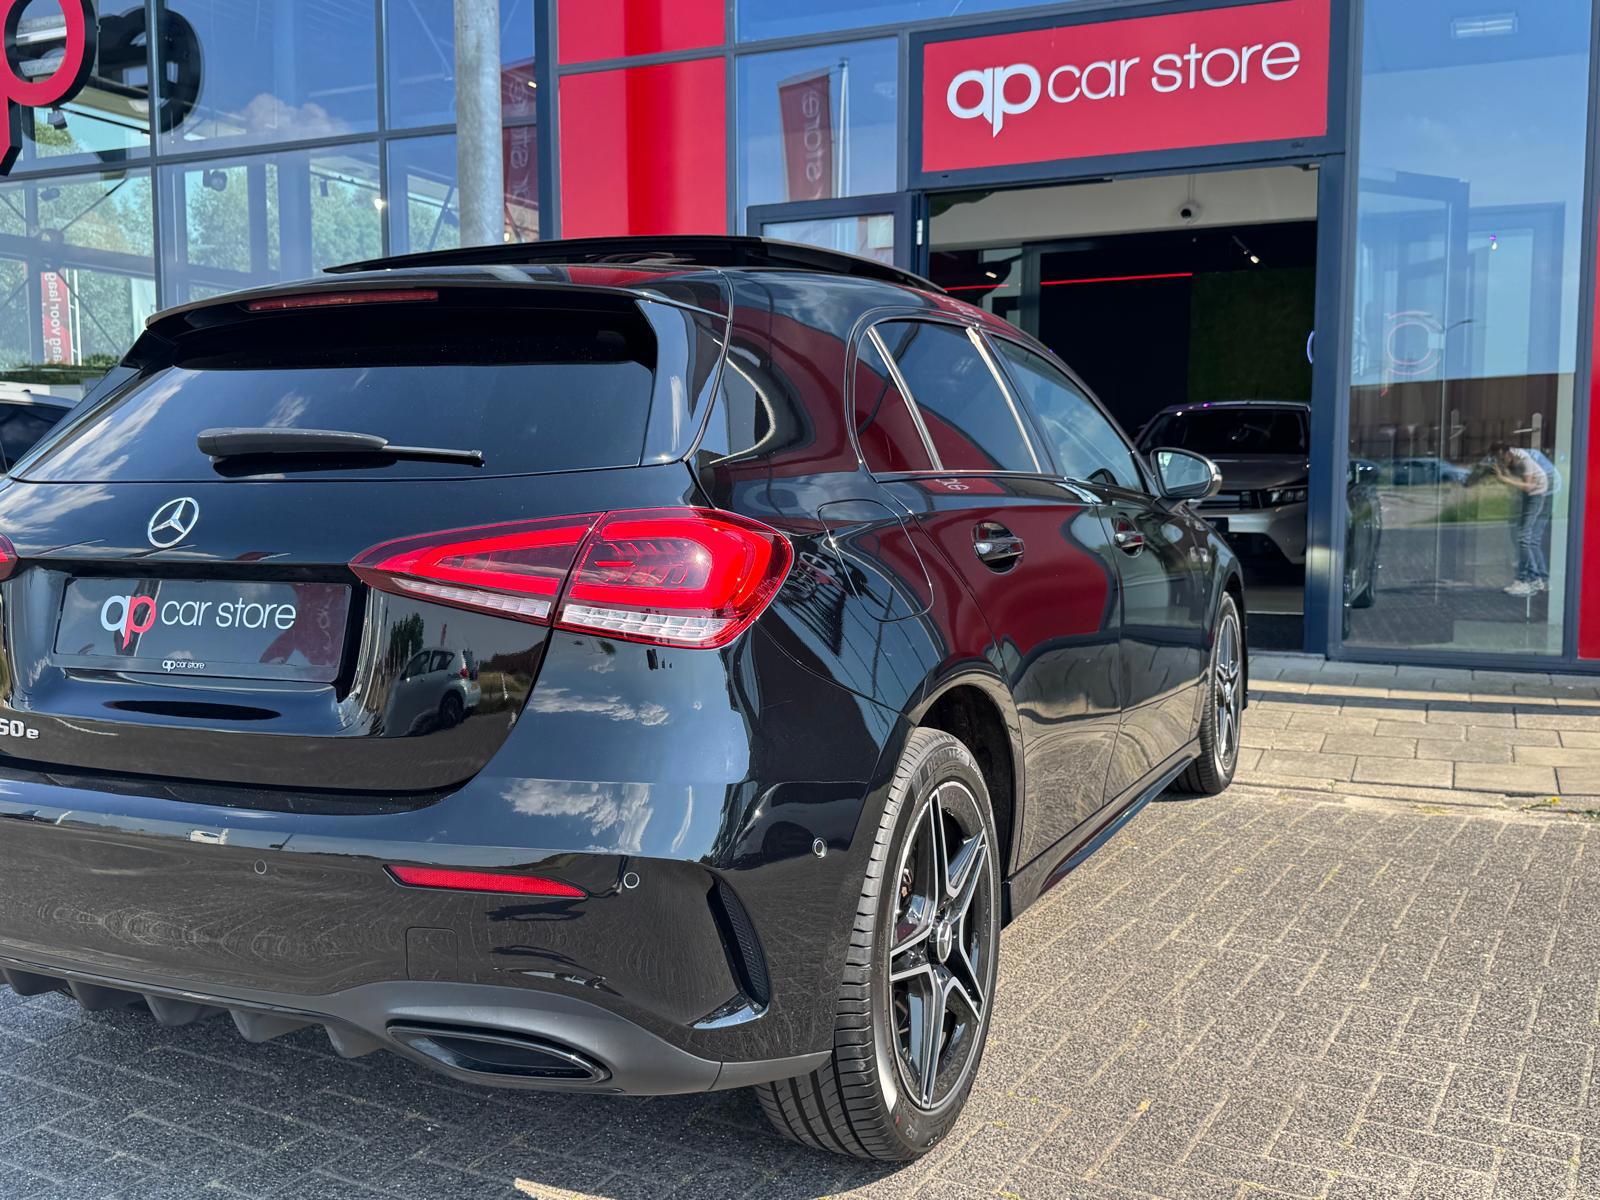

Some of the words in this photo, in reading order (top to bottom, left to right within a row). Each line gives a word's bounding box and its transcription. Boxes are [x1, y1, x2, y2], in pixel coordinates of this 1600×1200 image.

[1047, 57, 1140, 103] car
[1150, 41, 1301, 93] store
[161, 600, 212, 626] car
[215, 597, 297, 630] store
